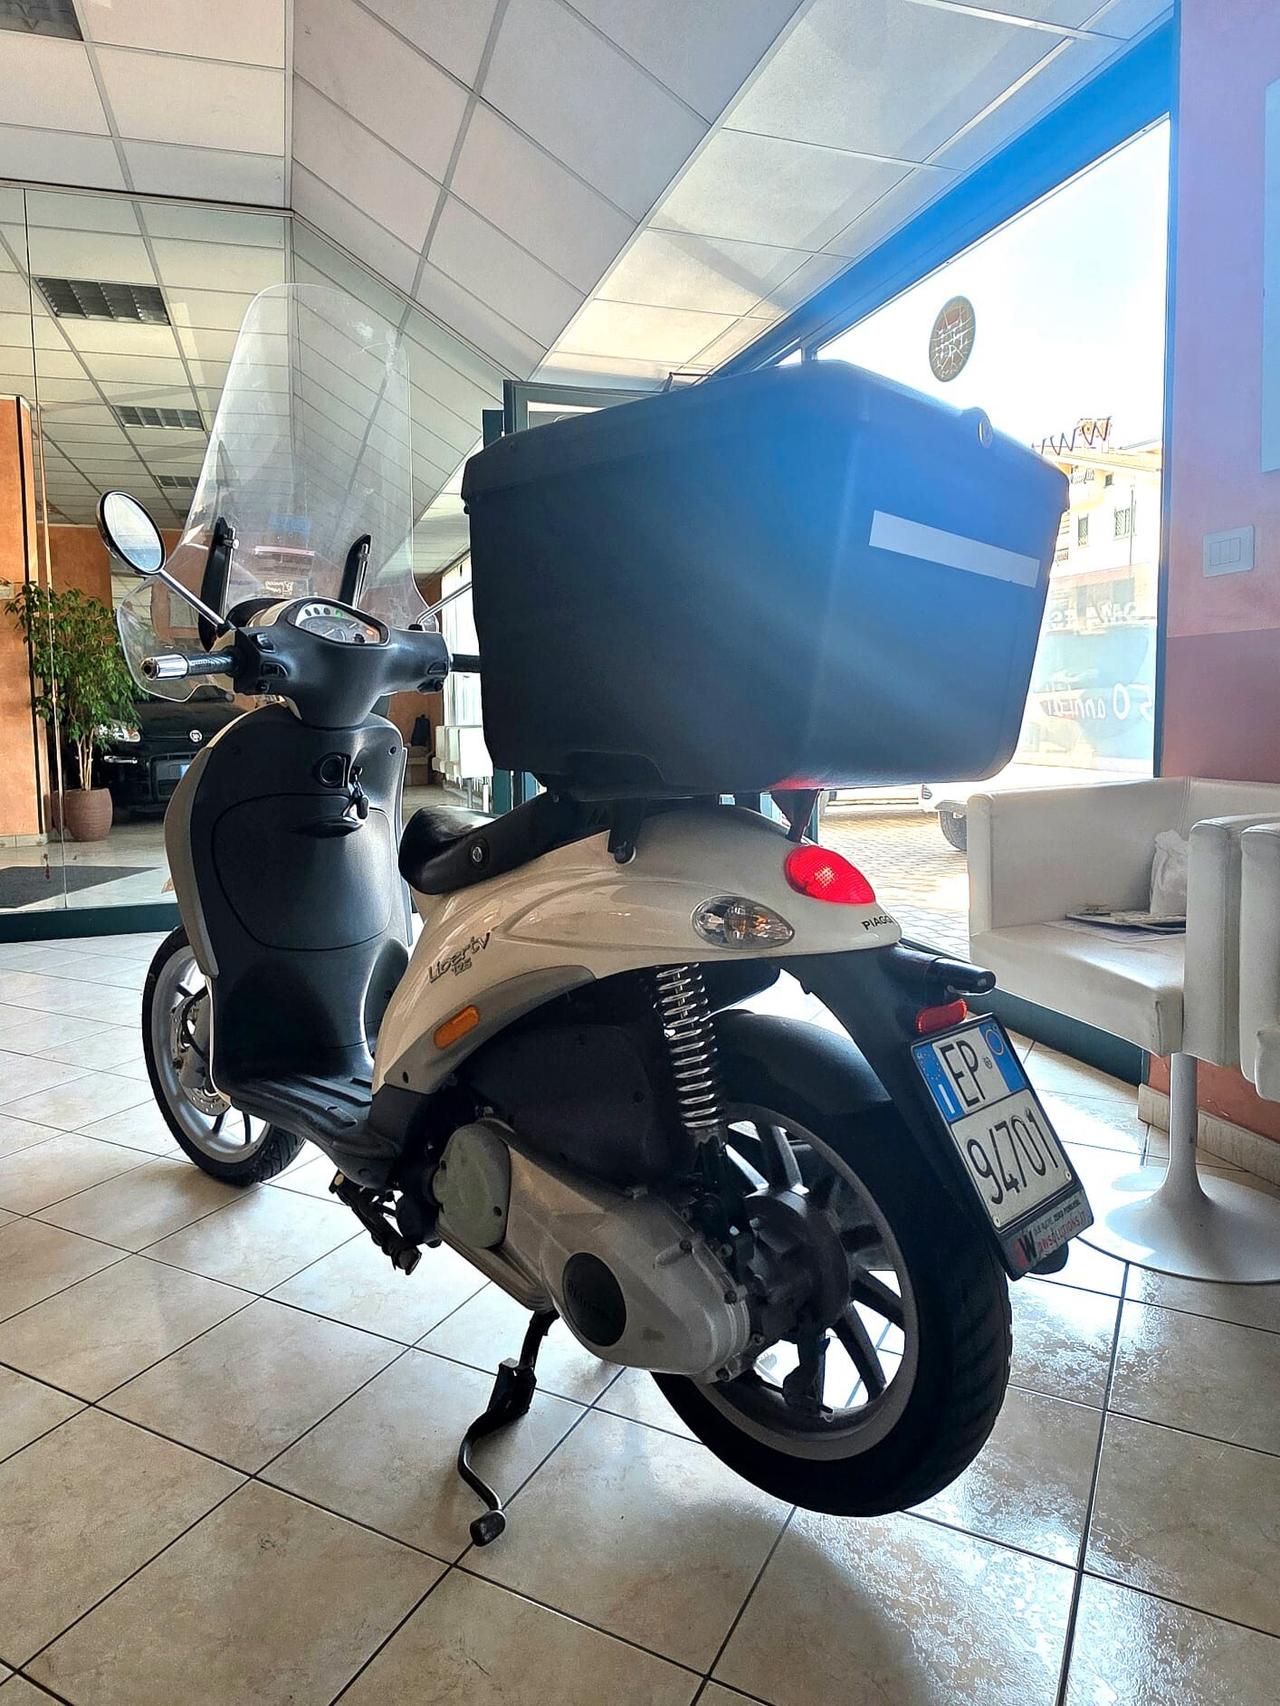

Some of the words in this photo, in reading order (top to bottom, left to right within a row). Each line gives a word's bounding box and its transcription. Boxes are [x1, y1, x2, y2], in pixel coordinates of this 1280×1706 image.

[429, 932, 490, 983] Liberty
[938, 1039, 986, 1108] EP
[966, 1107, 1059, 1205] 94701
